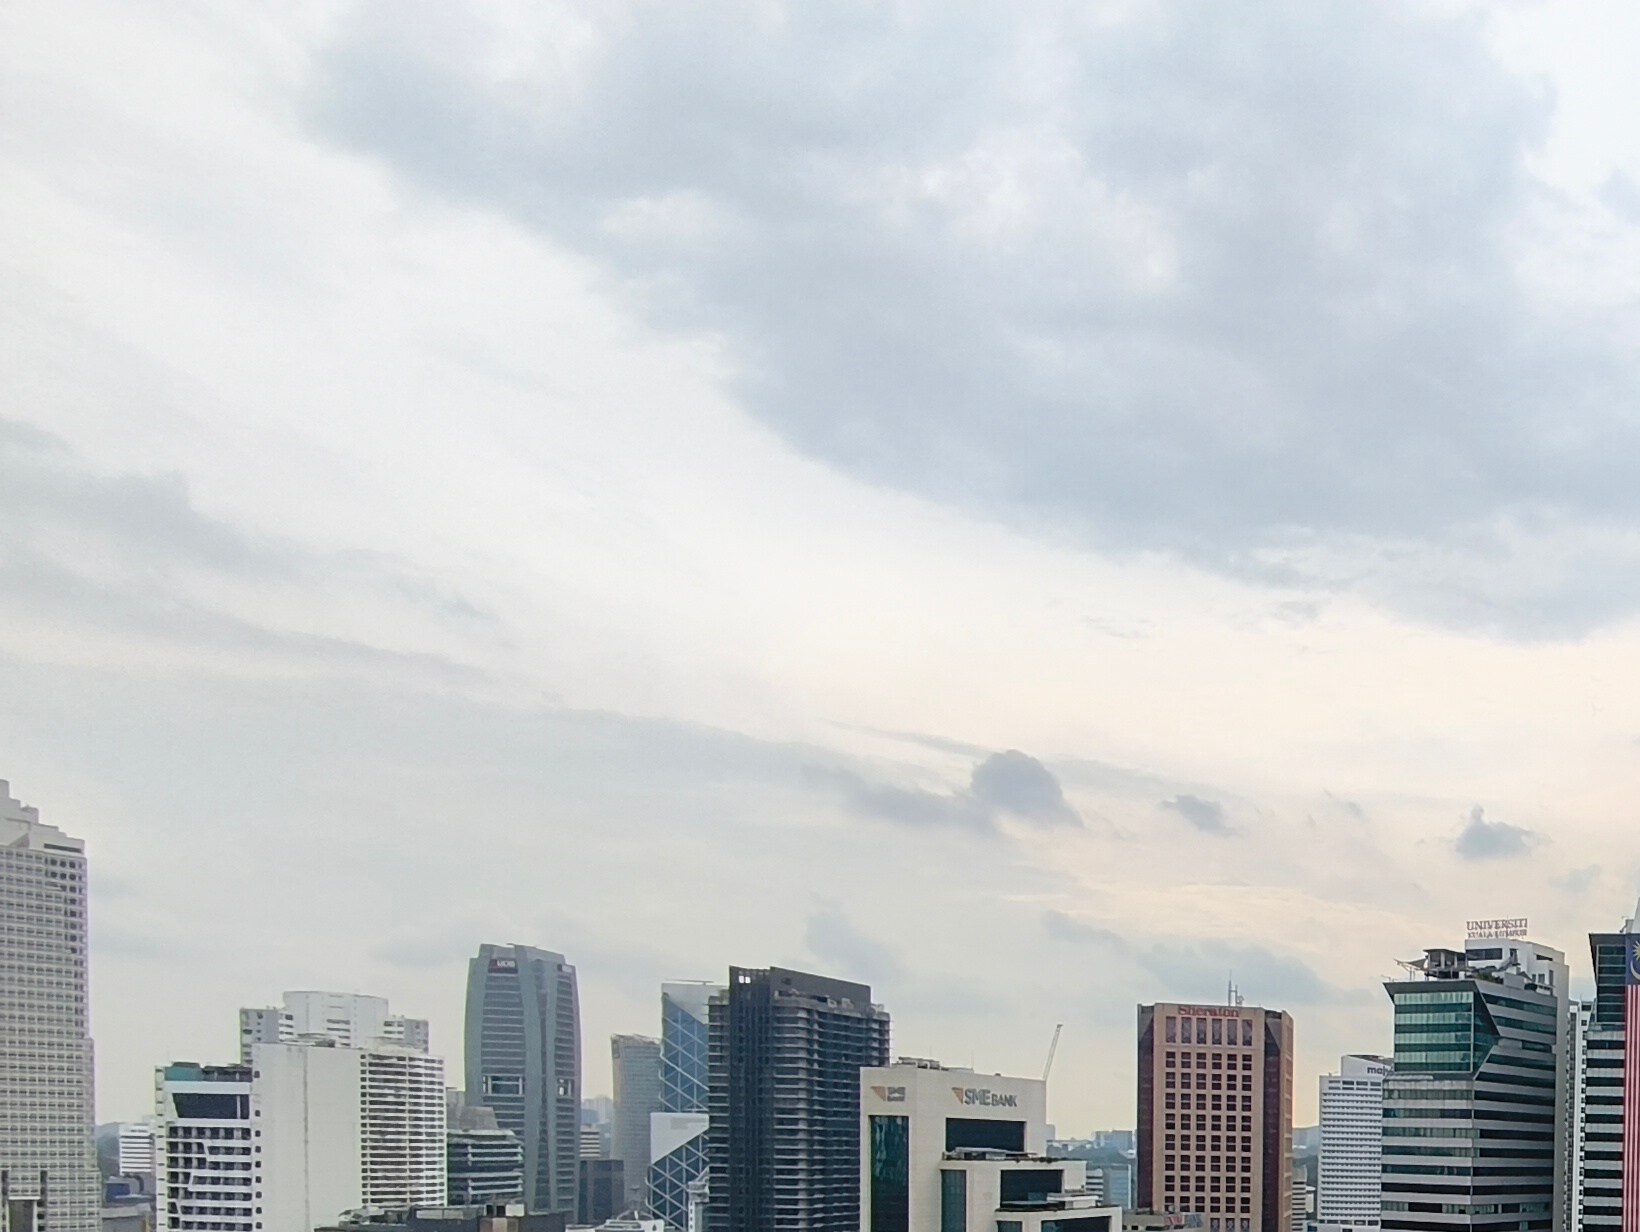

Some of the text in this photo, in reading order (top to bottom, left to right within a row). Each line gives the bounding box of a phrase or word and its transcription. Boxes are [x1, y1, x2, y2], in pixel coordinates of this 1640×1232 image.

[1466, 918, 1528, 930] UNIVERSITI
[1178, 1006, 1239, 1018] Sheraton
[964, 1088, 1017, 1107] SME BANK
